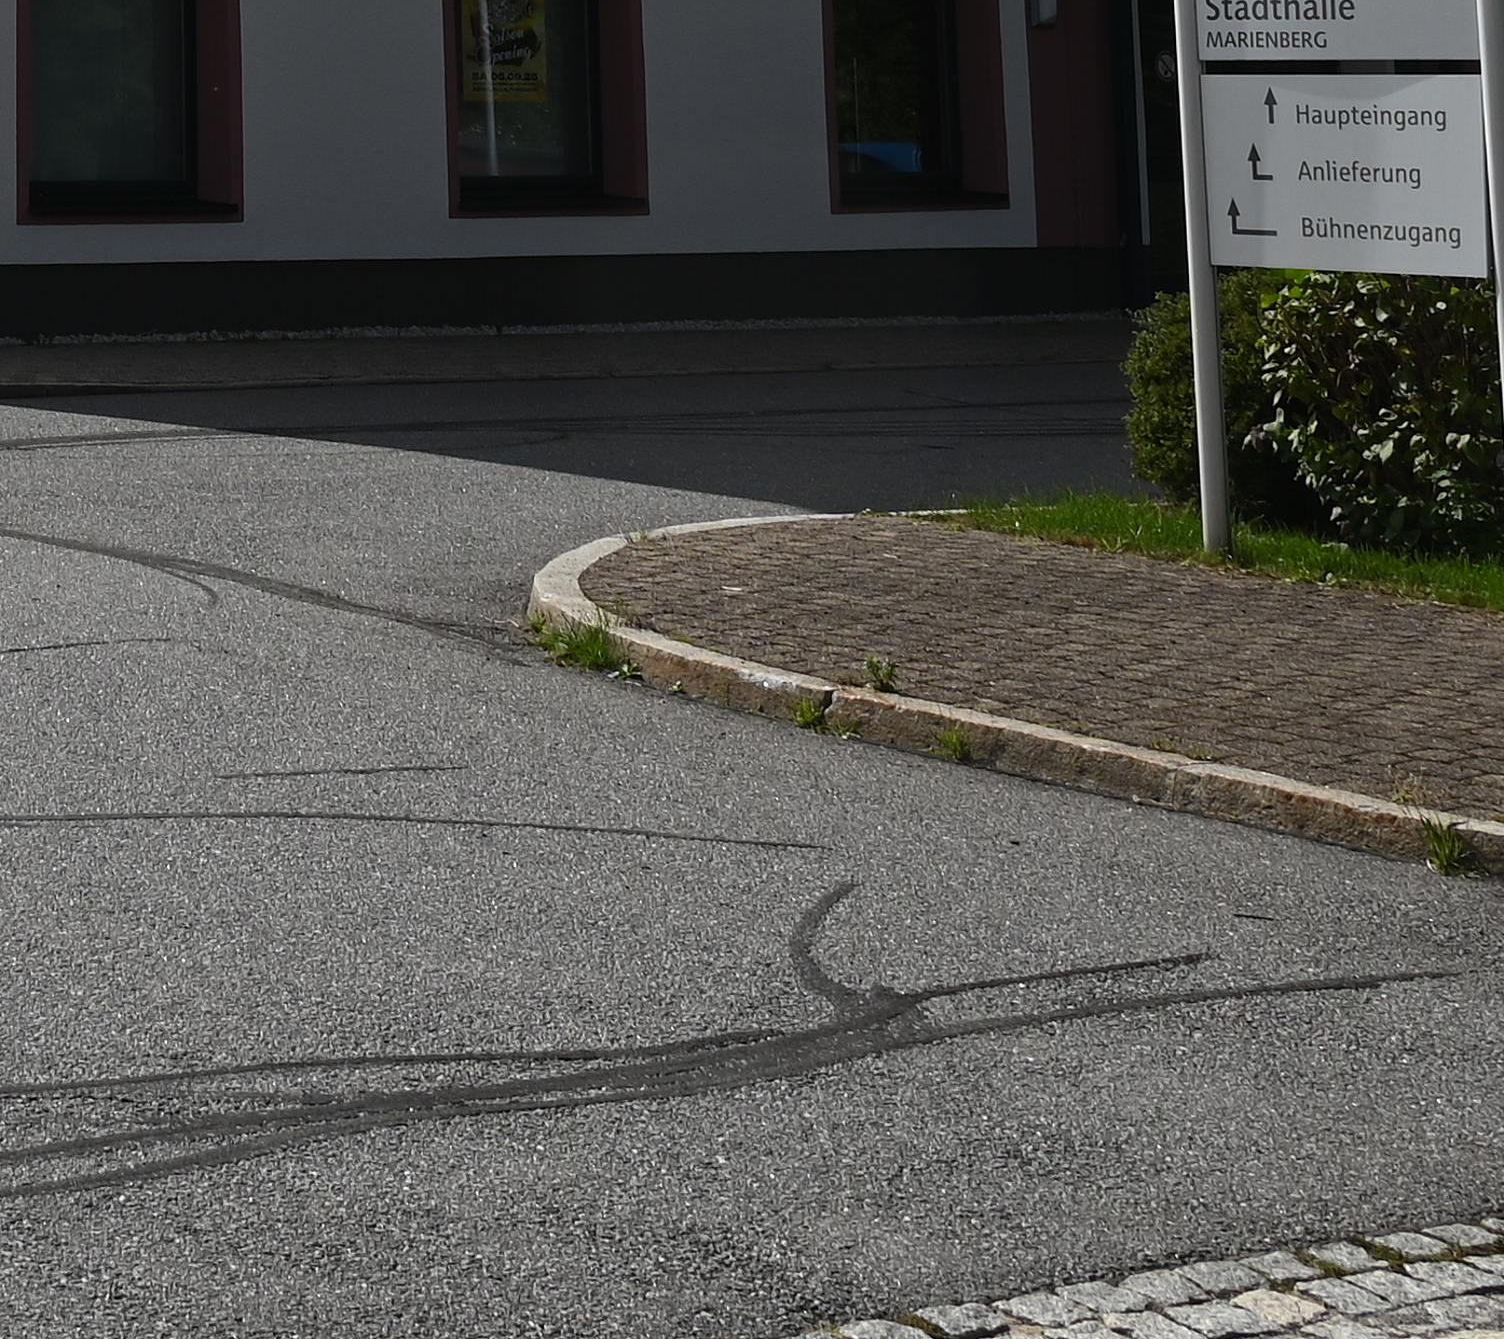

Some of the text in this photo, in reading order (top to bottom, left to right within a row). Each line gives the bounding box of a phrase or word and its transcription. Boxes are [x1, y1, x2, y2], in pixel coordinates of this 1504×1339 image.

[1206, 31, 1328, 49] MARIENBERG
[1295, 104, 1447, 132] Haupteingang
[1298, 160, 1422, 190] Anlieferung
[1301, 216, 1462, 250] Bühnenzugang
